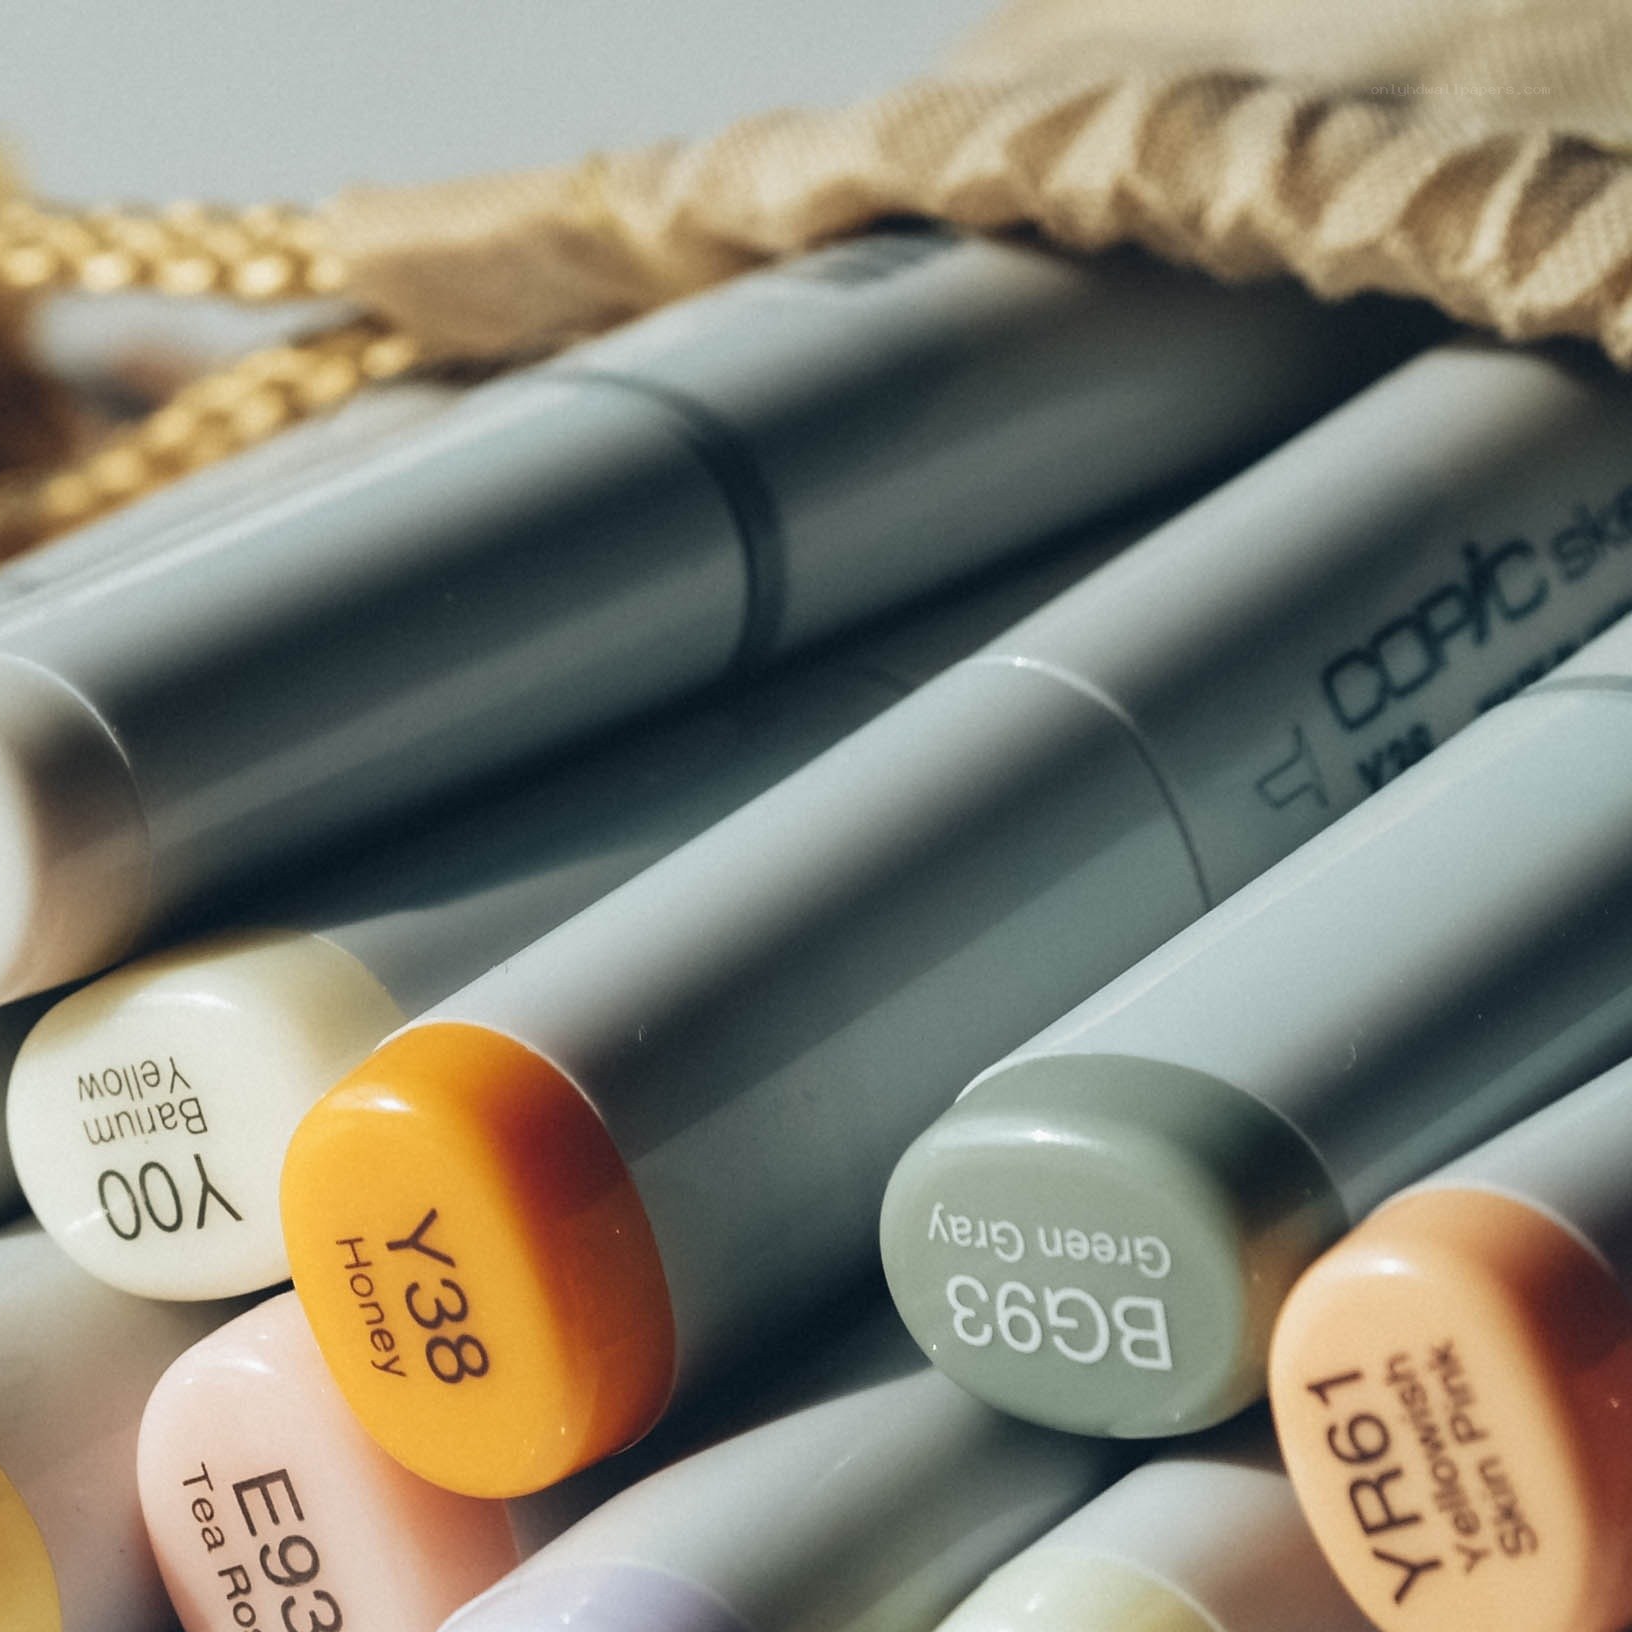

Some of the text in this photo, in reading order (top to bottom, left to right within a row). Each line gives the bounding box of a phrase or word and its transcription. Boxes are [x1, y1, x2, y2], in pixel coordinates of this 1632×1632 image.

[1321, 538, 1548, 732] COPIC
[78, 1057, 192, 1103] Yellow
[82, 1097, 208, 1145] Barium
[97, 1153, 243, 1241] Y00
[928, 1201, 1172, 1279] Green Gray
[336, 1236, 407, 1378] Honey
[386, 1208, 489, 1384] Y38
[946, 1274, 1172, 1371] BG93
[1305, 1369, 1443, 1607] YR61
[1385, 1351, 1492, 1575] Yellowish
[1428, 1335, 1540, 1559] Skin Pink
[182, 1461, 225, 1553] Tea
